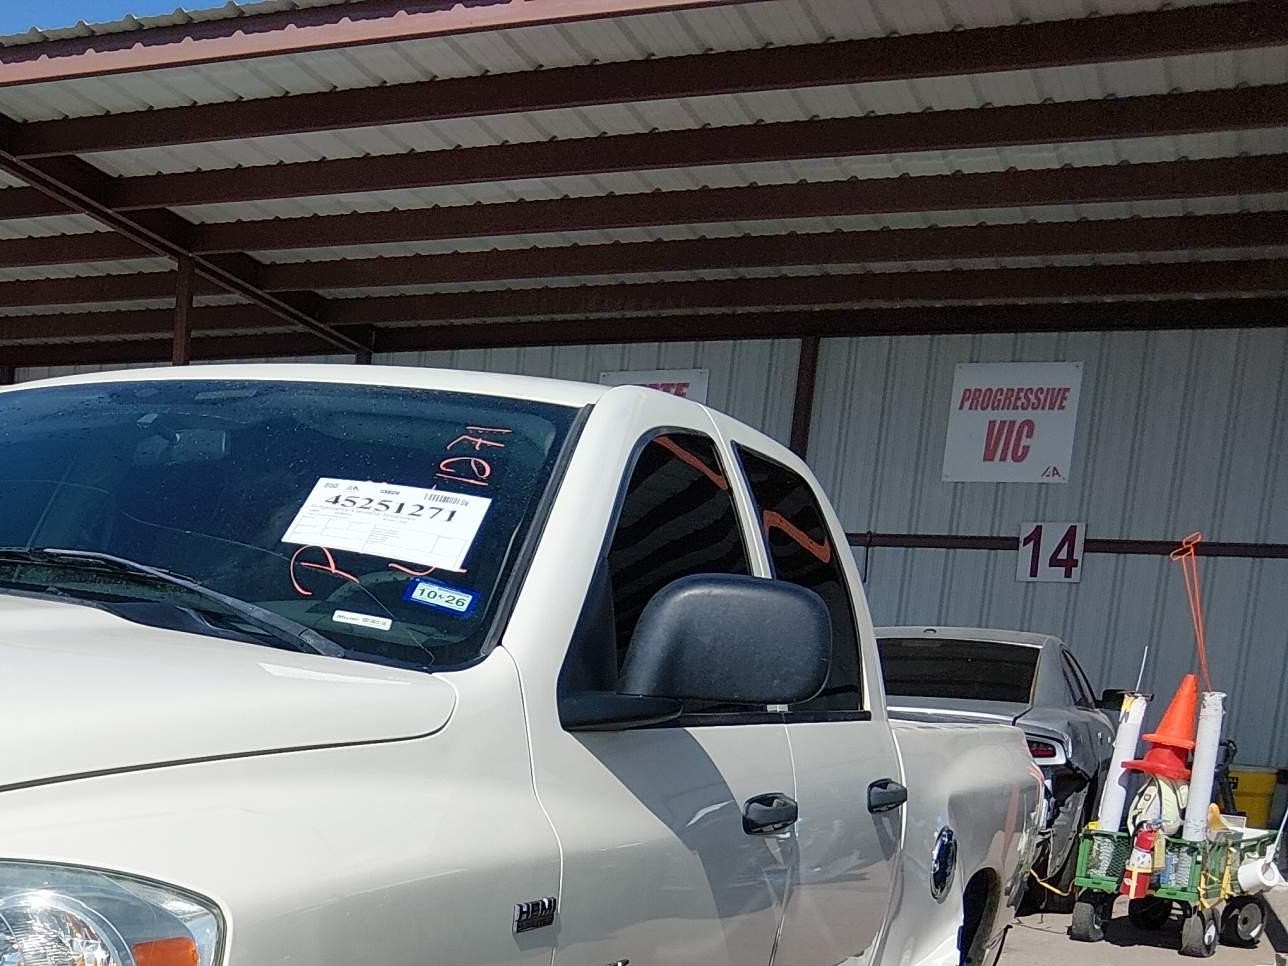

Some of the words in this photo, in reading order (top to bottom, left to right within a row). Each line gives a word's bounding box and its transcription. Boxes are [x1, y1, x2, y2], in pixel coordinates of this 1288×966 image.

[958, 387, 1071, 411] PROGRESSIVE
[983, 419, 1035, 463] VIC
[325, 494, 457, 522] 45251271
[1023, 525, 1079, 578] 14
